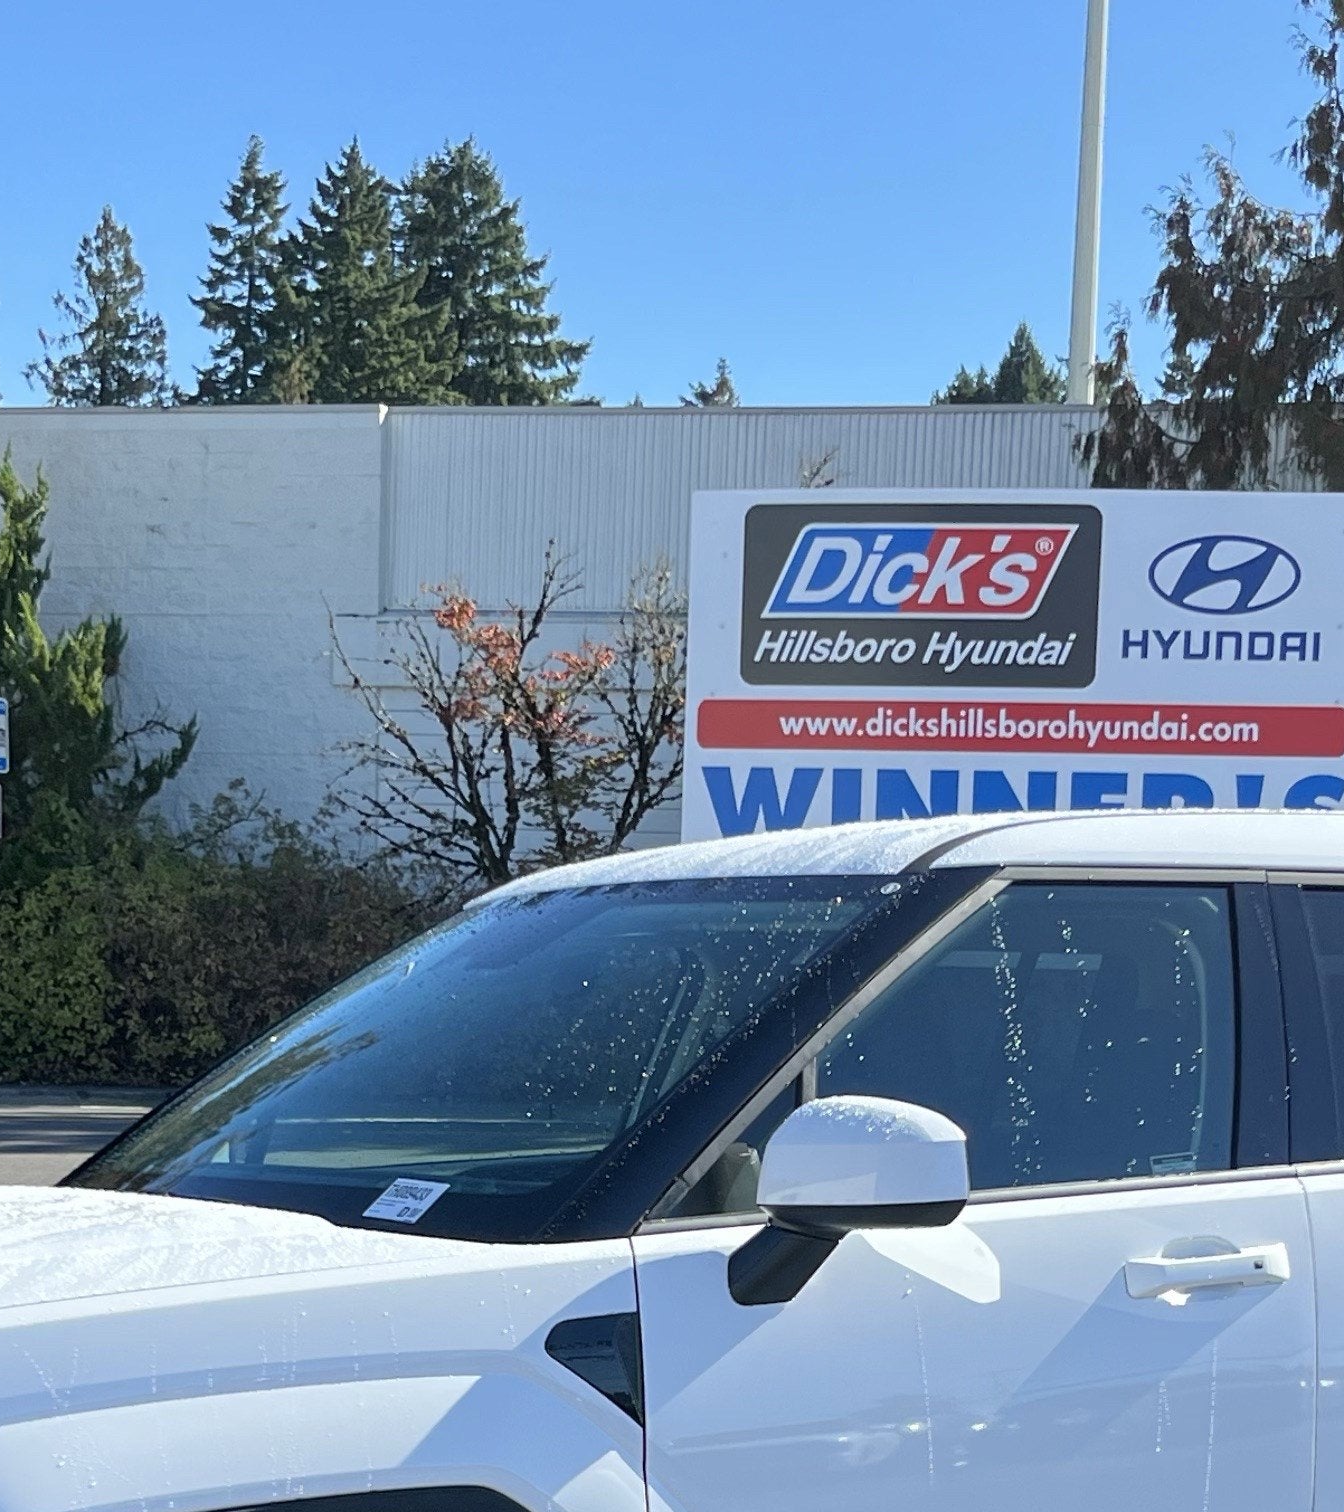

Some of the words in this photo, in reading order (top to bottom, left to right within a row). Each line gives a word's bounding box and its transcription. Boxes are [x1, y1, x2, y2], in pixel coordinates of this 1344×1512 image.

[786, 534, 1038, 607] Dick's
[753, 630, 917, 664] Hillsboro
[921, 631, 1077, 674] Hyundai
[1121, 629, 1321, 662] HYUNDAI
[779, 706, 1259, 748] www.dickshillsborohyundai.com
